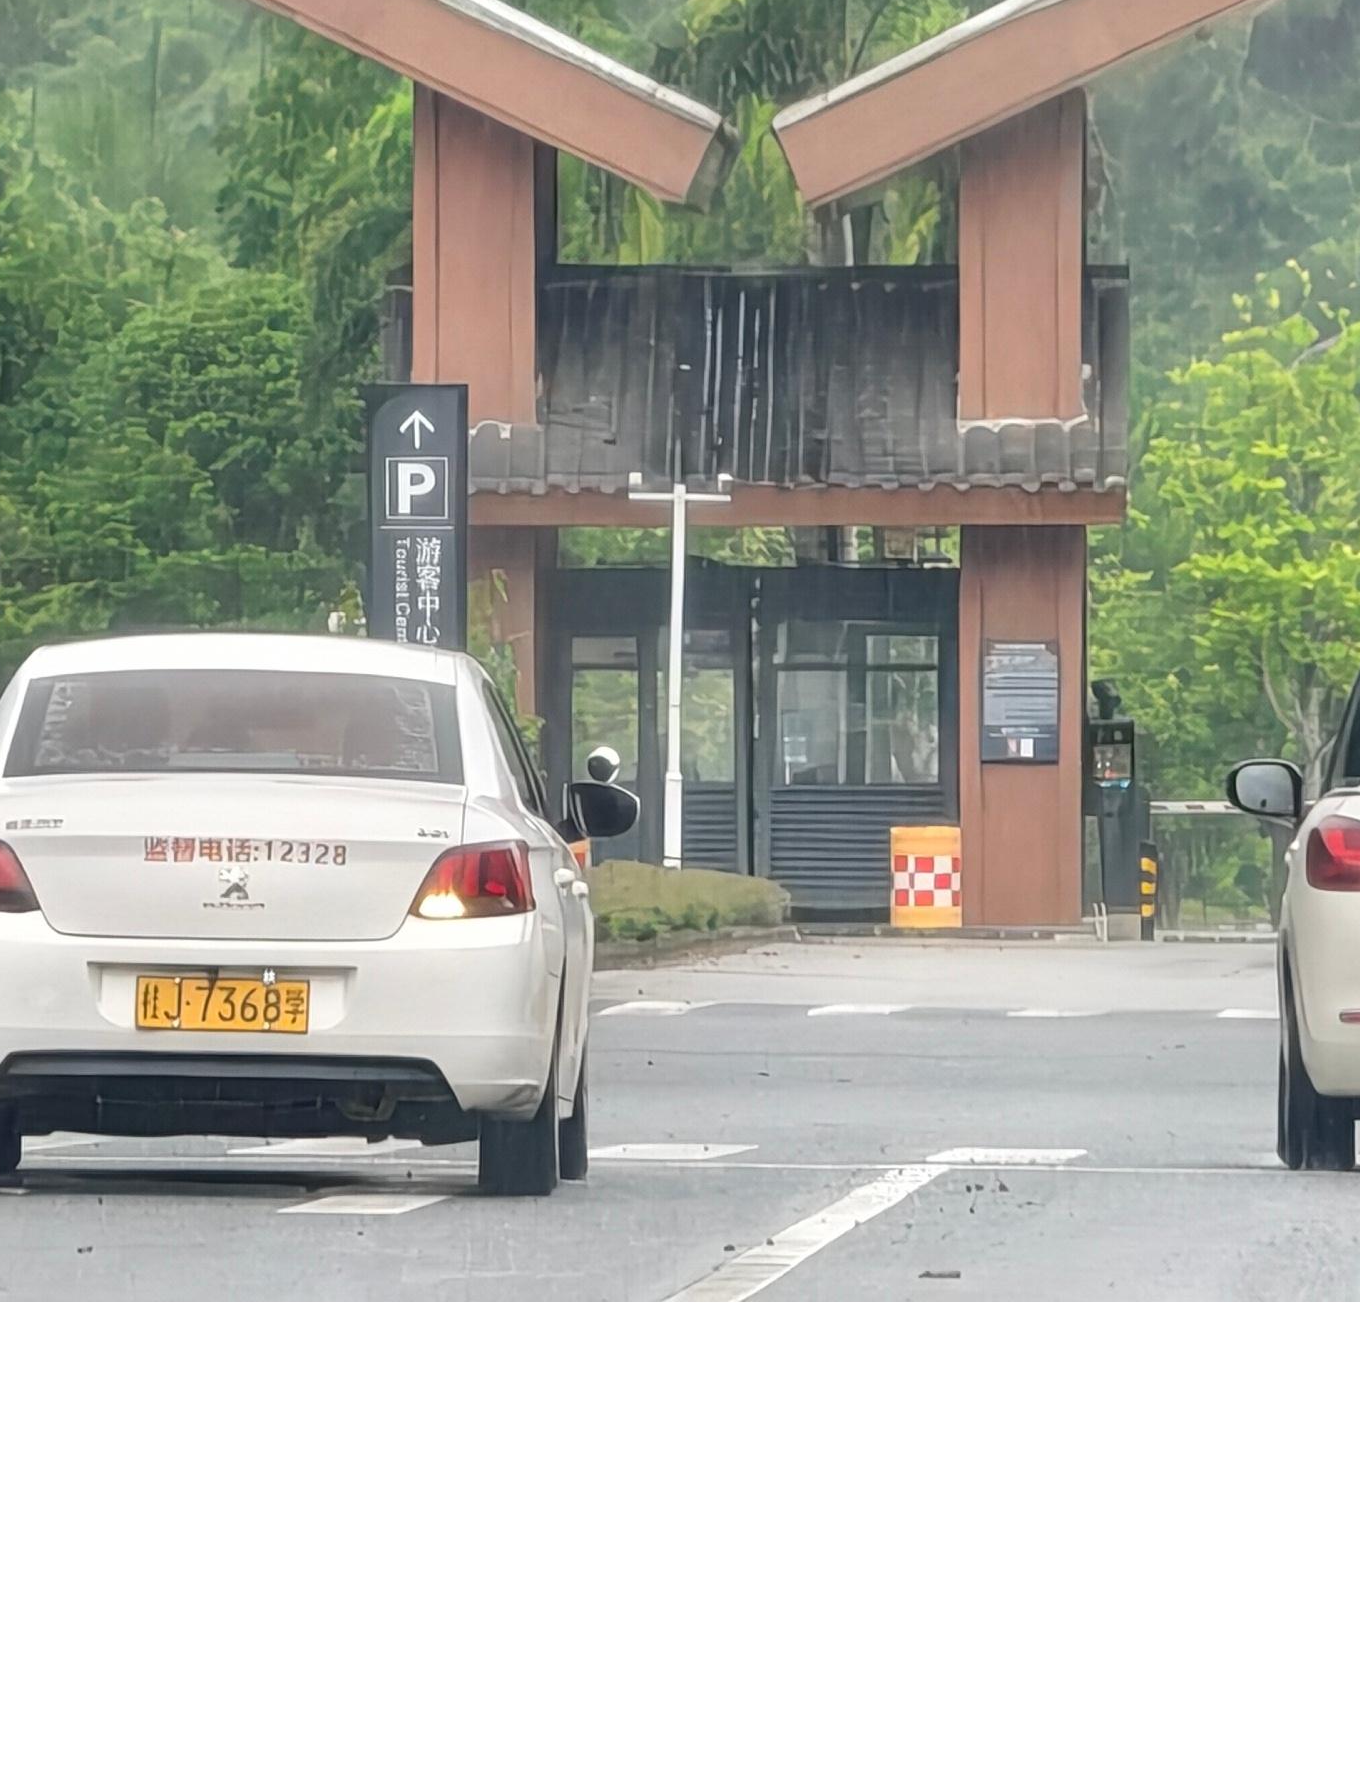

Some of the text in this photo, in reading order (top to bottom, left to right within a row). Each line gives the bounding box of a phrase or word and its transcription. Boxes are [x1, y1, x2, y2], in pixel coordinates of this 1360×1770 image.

[397, 462, 436, 515] P
[396, 537, 410, 599] Tourist
[416, 536, 441, 644] 游客中心
